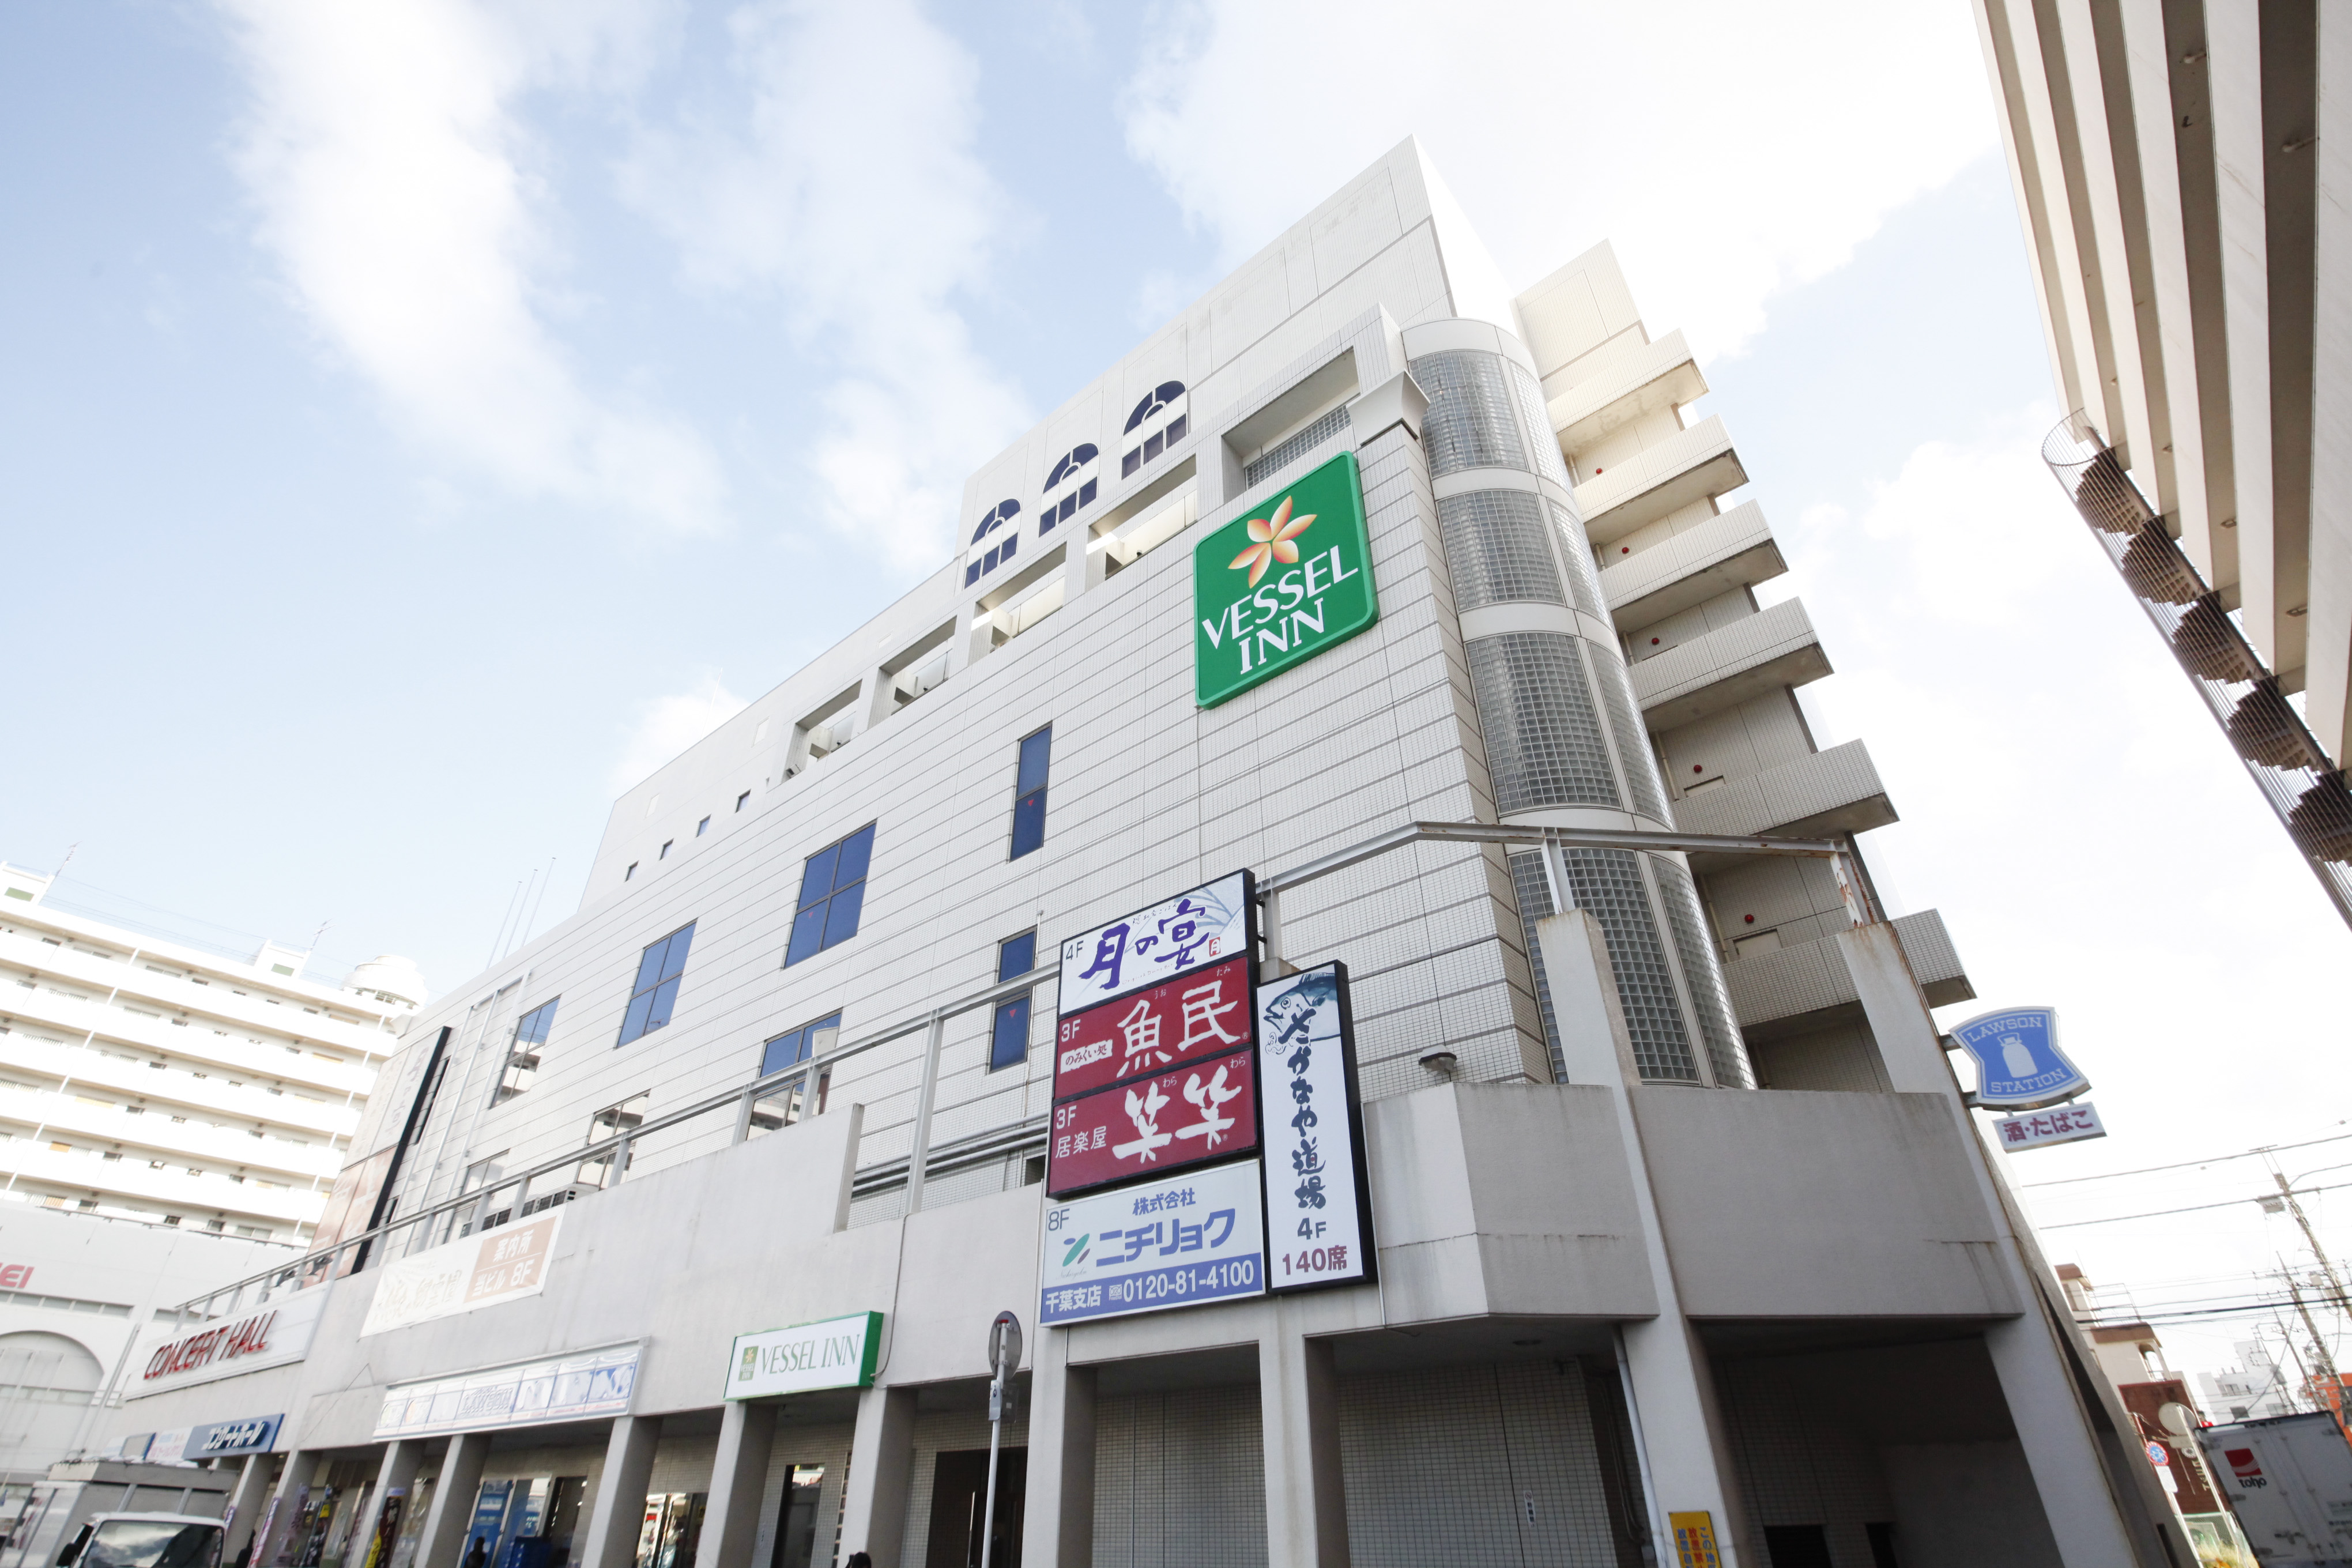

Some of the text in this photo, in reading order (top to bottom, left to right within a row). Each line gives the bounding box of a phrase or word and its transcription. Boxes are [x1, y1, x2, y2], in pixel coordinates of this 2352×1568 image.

[1202, 545, 1359, 650] VESSEL
[1239, 597, 1325, 675] INN
[1066, 940, 1084, 960] 4F
[1078, 898, 1209, 989] 月の宴
[1216, 966, 1231, 977] たみ
[1154, 988, 1167, 1000] うお
[1061, 1019, 1081, 1042] 3F
[1117, 980, 1241, 1078] 魚民
[1967, 1017, 2043, 1042] LAWSON
[1065, 1045, 1107, 1066] のみくい処
[1230, 1056, 1246, 1069] わら
[1163, 1076, 1177, 1088] わら
[1991, 1068, 2067, 1092] STATION
[1056, 1105, 1077, 1129] 3F
[1112, 1064, 1242, 1164] 笑笑
[1278, 1008, 1326, 1209] さかなや道場
[1055, 1125, 1107, 1159] 居楽屋
[1132, 1188, 1196, 1216] 株式会社
[1048, 1208, 1070, 1231] 8F
[1297, 1217, 1326, 1240] 4F
[492, 1229, 535, 1262] 案内所
[1096, 1208, 1235, 1267] ニチリョク
[510, 1259, 535, 1286] 8F
[1283, 1245, 1347, 1275] 140席
[0, 1262, 35, 1288] EI
[1124, 1260, 1254, 1302] 0120-81-4100
[1045, 1284, 1102, 1314] 千葉支店
[144, 1310, 278, 1380] CONCERT HALL
[762, 1334, 860, 1375] VESSEL INN
[740, 1364, 754, 1372] VESSEL
[202, 1420, 265, 1450] コンサートホール
[2239, 1477, 2267, 1489] toho
